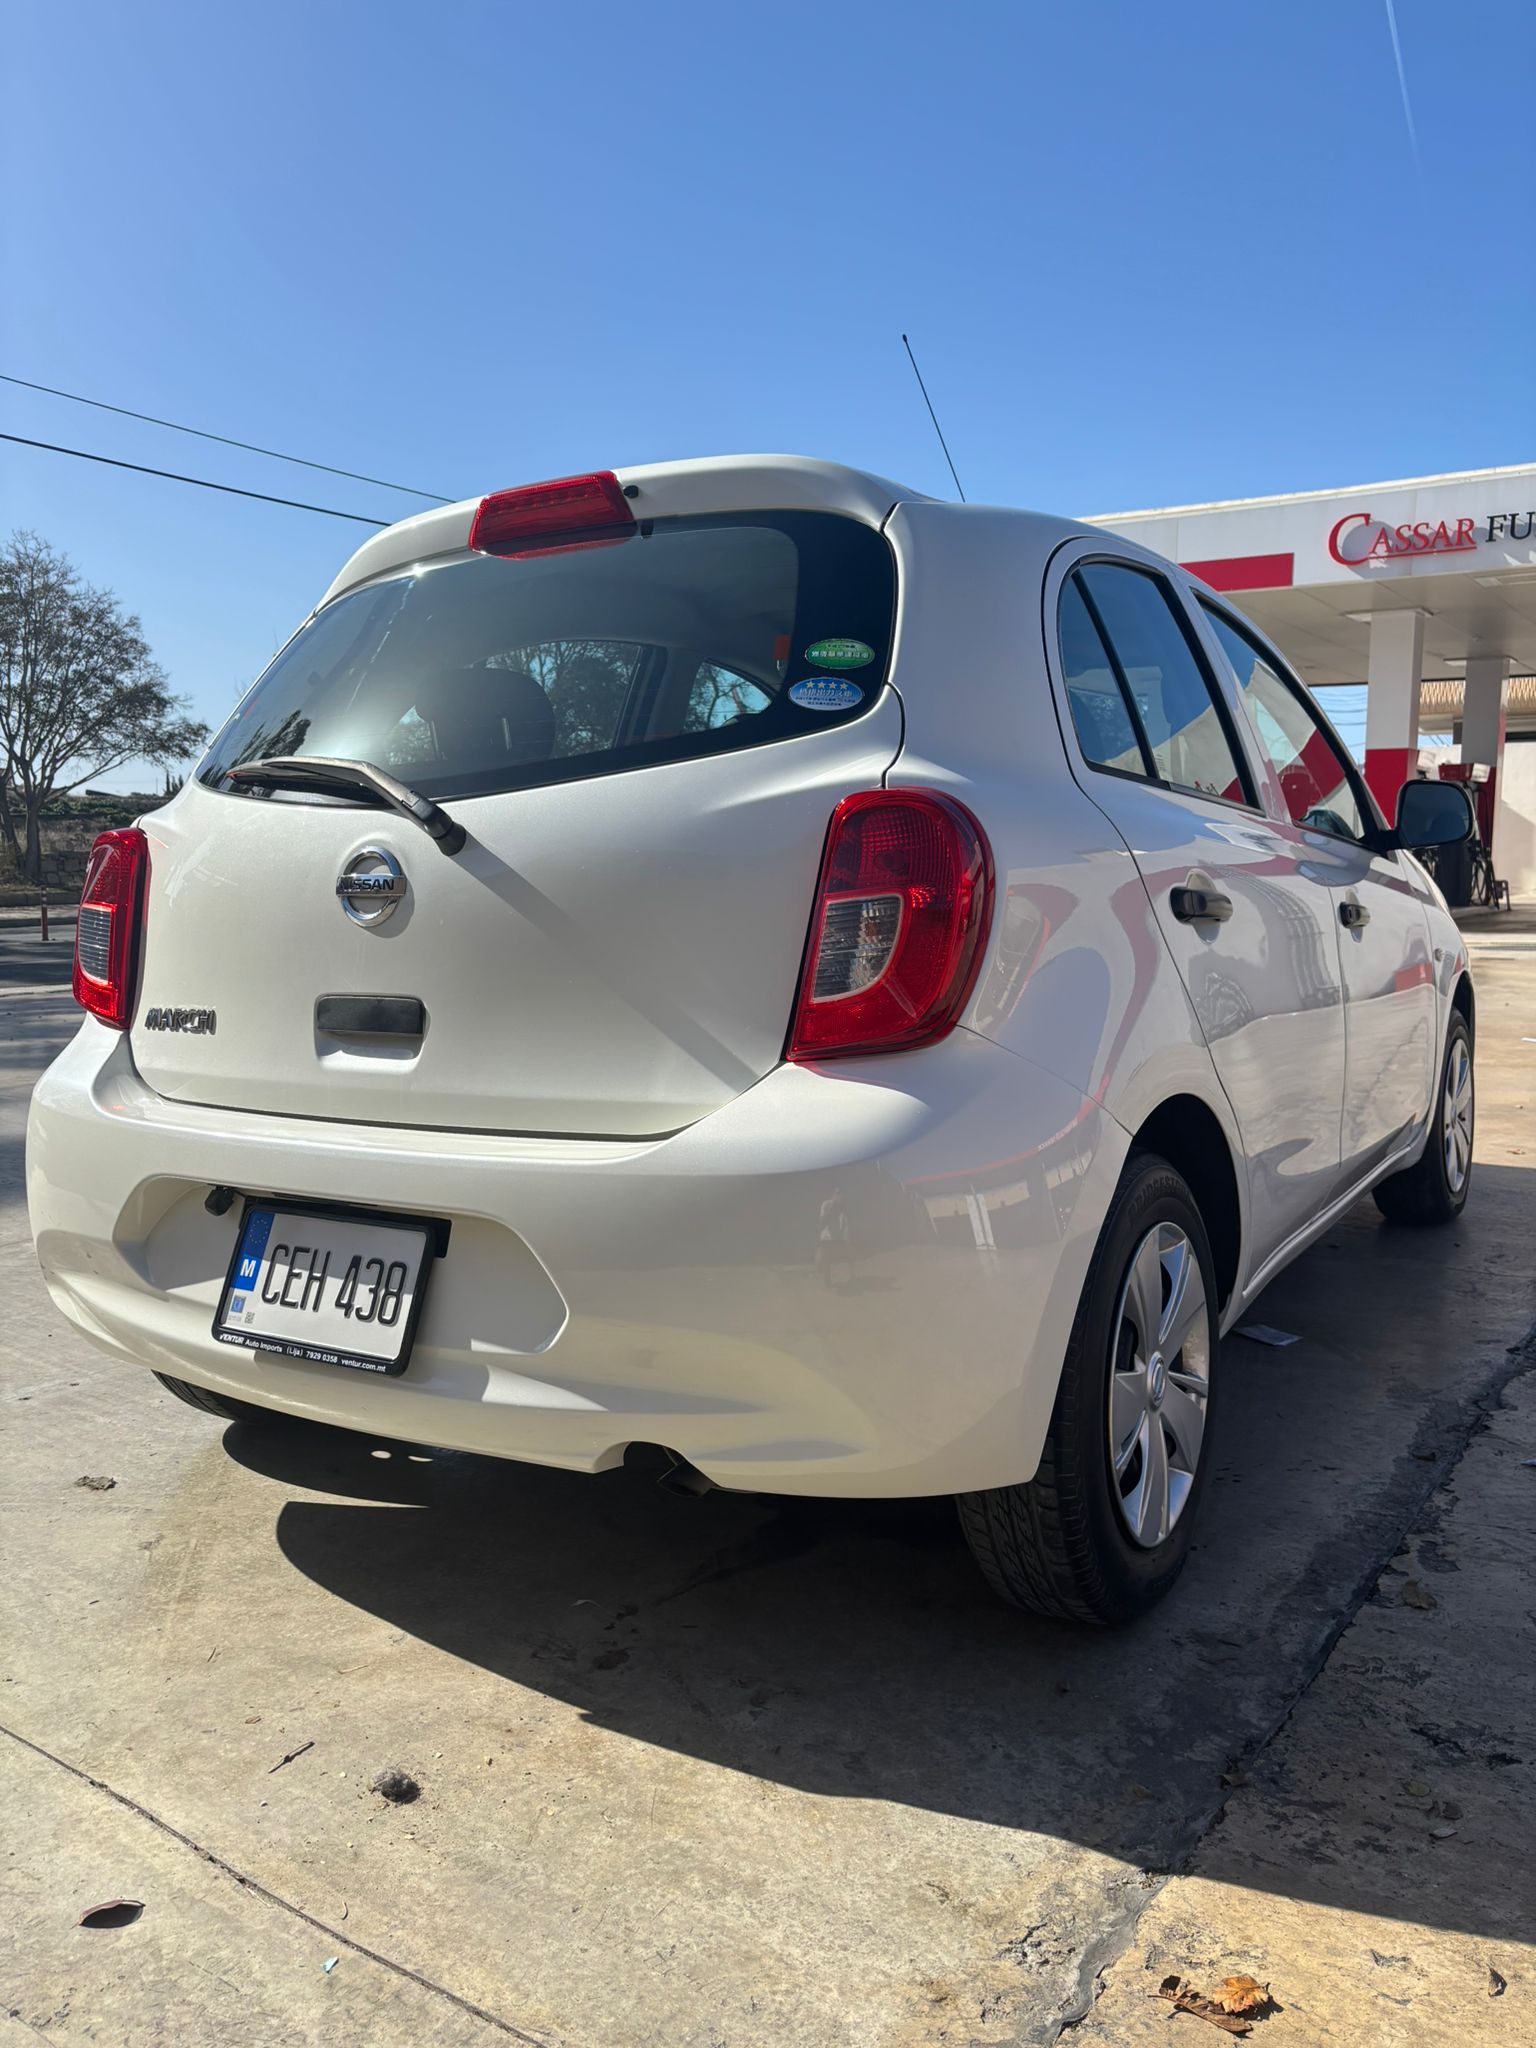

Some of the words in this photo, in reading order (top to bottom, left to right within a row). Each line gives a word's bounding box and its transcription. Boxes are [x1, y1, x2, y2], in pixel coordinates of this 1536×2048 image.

[1328, 512, 1477, 566] CASSAR
[340, 876, 395, 891] NISSAN
[240, 1258, 257, 1278] M
[261, 1243, 331, 1313] CEH
[334, 1254, 408, 1326] 438
[219, 1333, 245, 1344] VENTUR
[245, 1339, 260, 1349] Auto
[260, 1342, 283, 1353] Imports
[306, 1350, 322, 1361] 7929
[341, 1358, 387, 1373] ventur.com.mt
